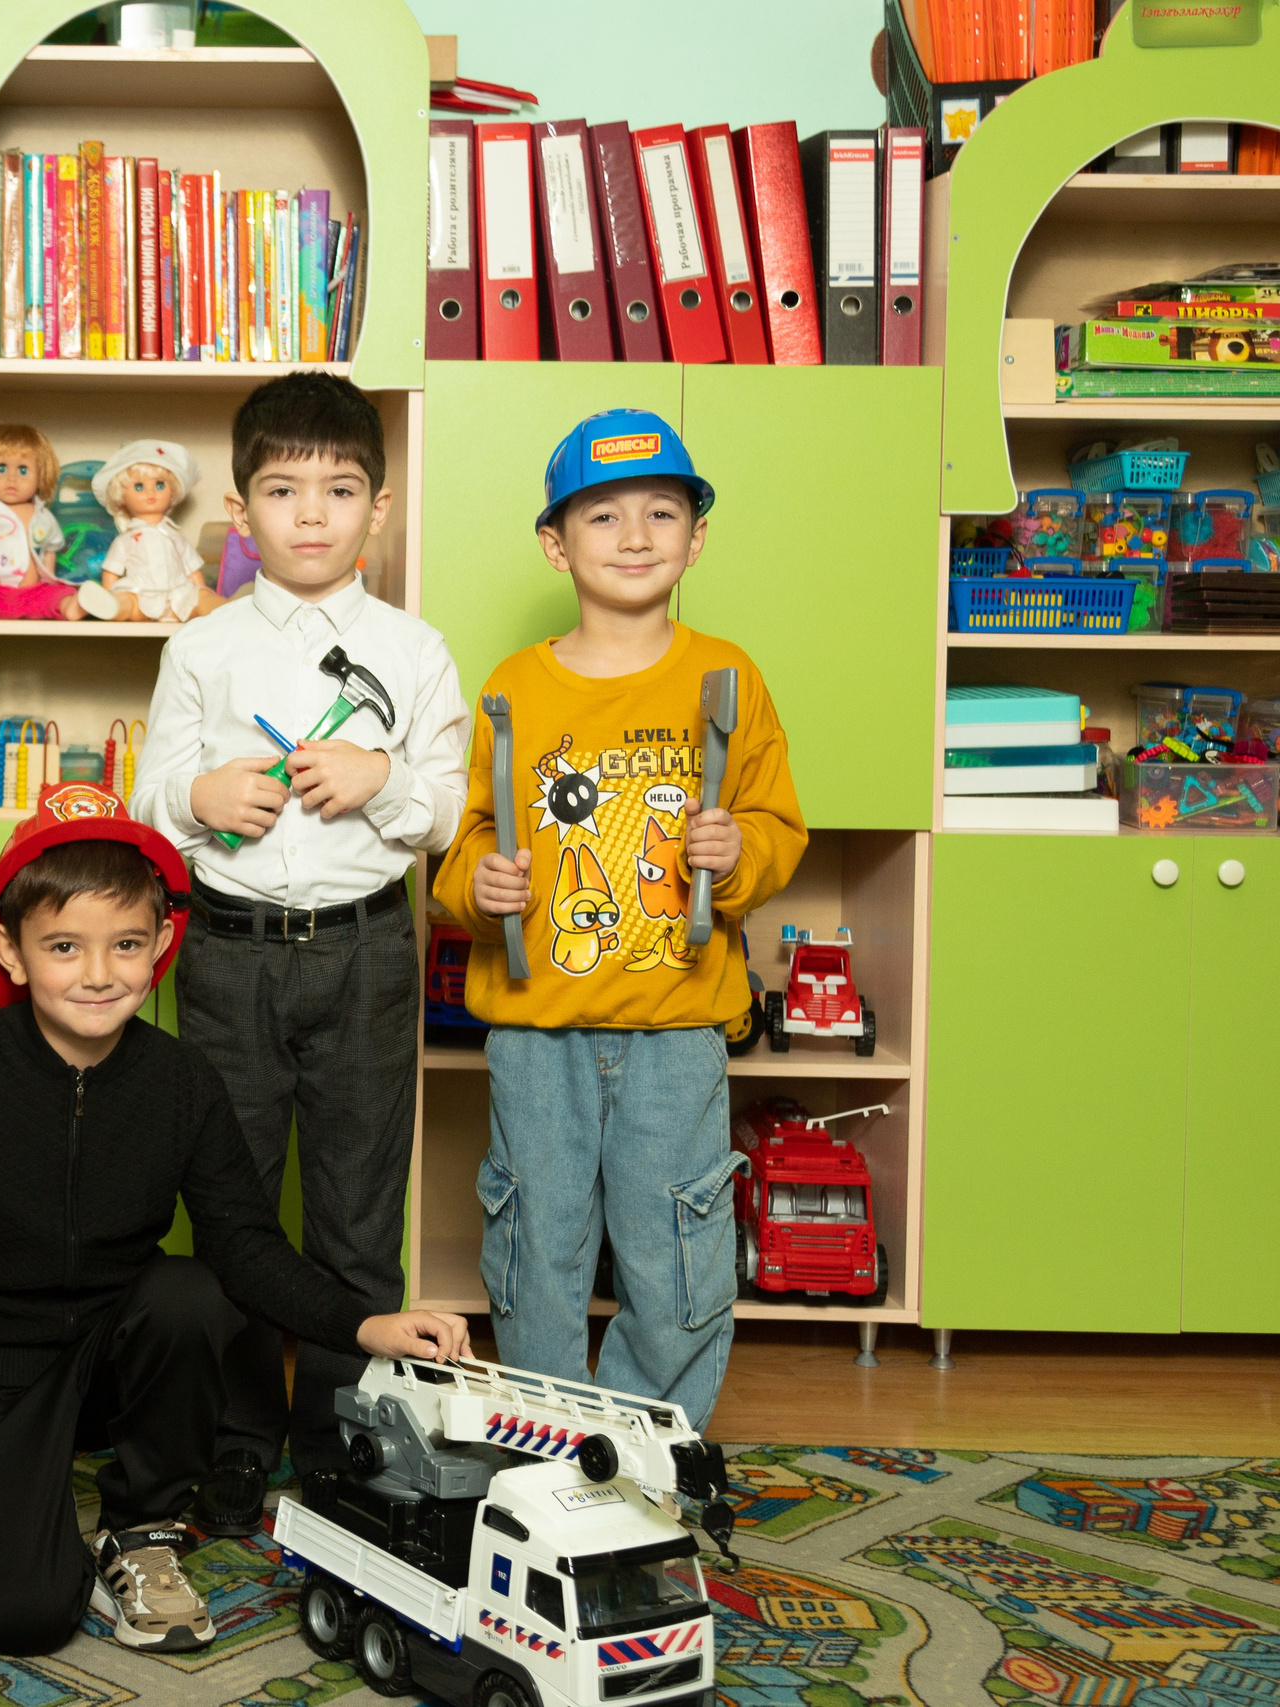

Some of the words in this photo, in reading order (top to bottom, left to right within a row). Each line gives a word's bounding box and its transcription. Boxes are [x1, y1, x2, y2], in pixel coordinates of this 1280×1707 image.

[449, 141, 460, 212] родителями
[666, 154, 683, 219] программа
[140, 187, 156, 236] РОССИИ
[140, 238, 157, 277] КНИГА
[447, 225, 458, 264] Работа
[677, 221, 691, 270] Рабочая
[141, 279, 157, 333] КРАСНАЯ
[1177, 305, 1264, 318] ЦИФРЫ
[596, 438, 655, 456] ПОЛЕСЬЕ
[623, 728, 677, 743] LEVEL
[682, 728, 690, 742] 1
[649, 793, 683, 803] HELLO
[600, 1664, 627, 1673] VOLVO
